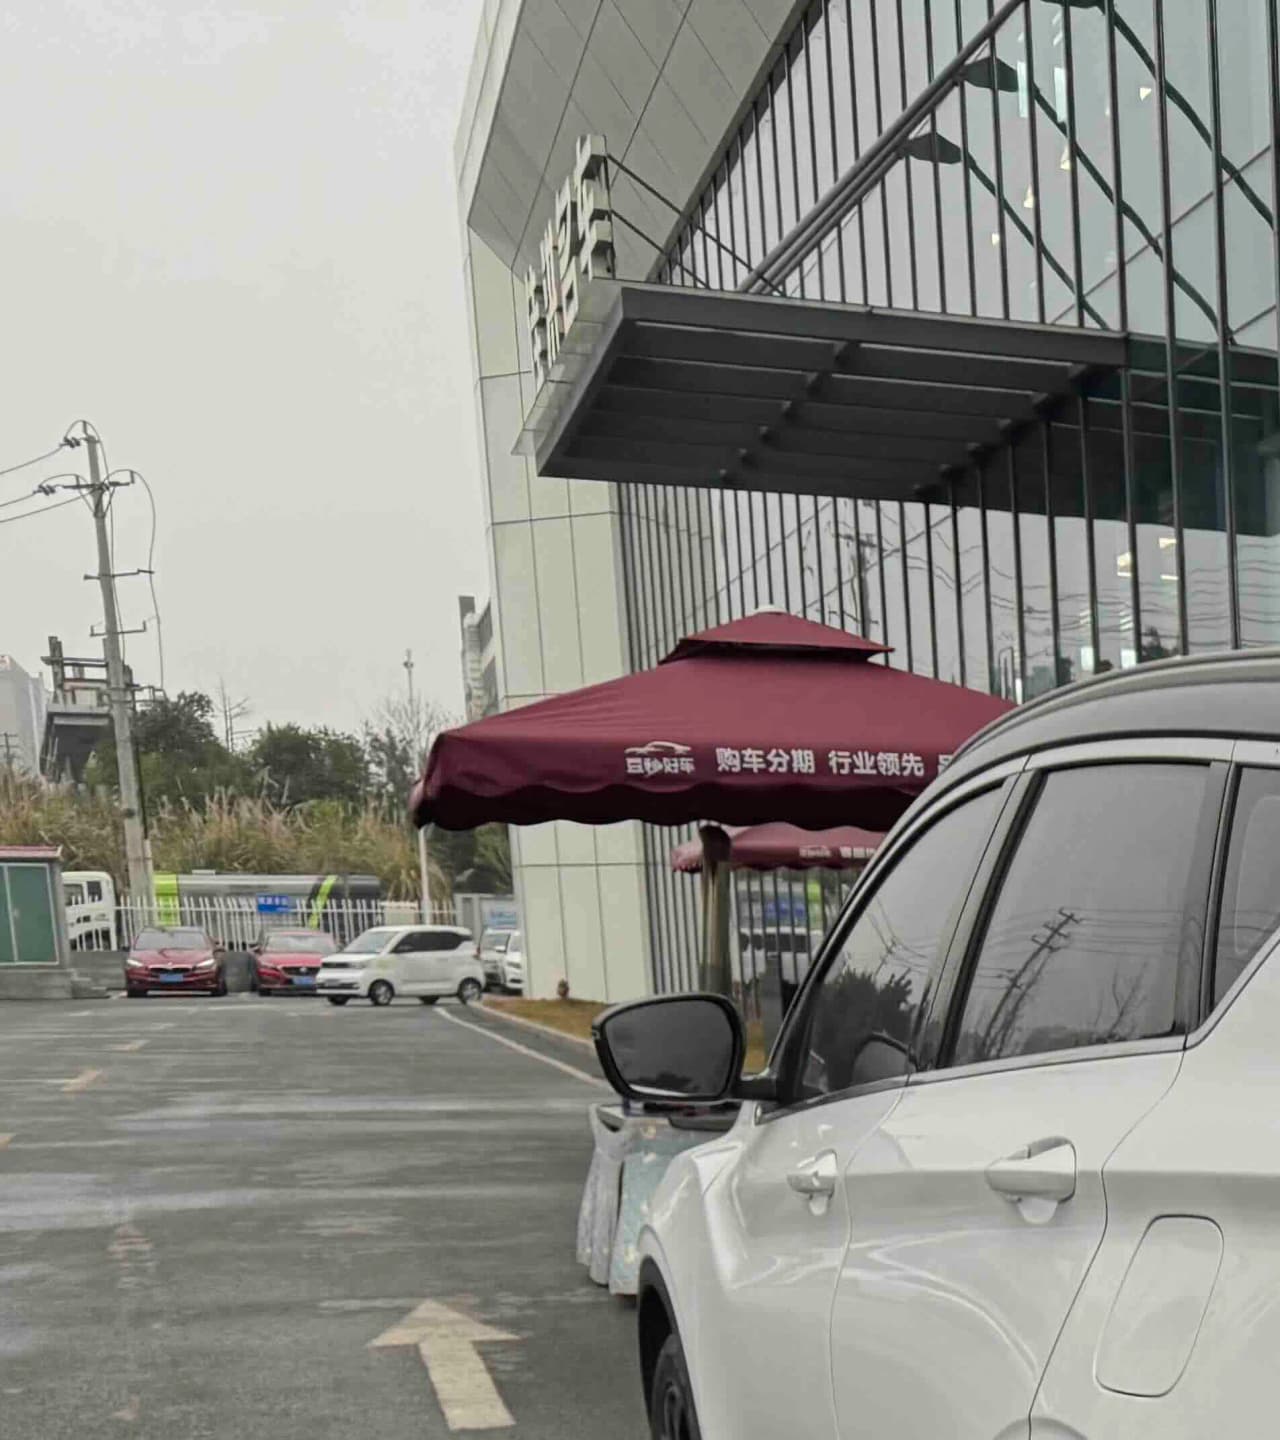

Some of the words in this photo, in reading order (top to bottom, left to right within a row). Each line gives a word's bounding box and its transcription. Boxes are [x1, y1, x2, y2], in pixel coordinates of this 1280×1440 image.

[715, 747, 816, 775] 购车分期
[828, 751, 925, 777] 行业领先
